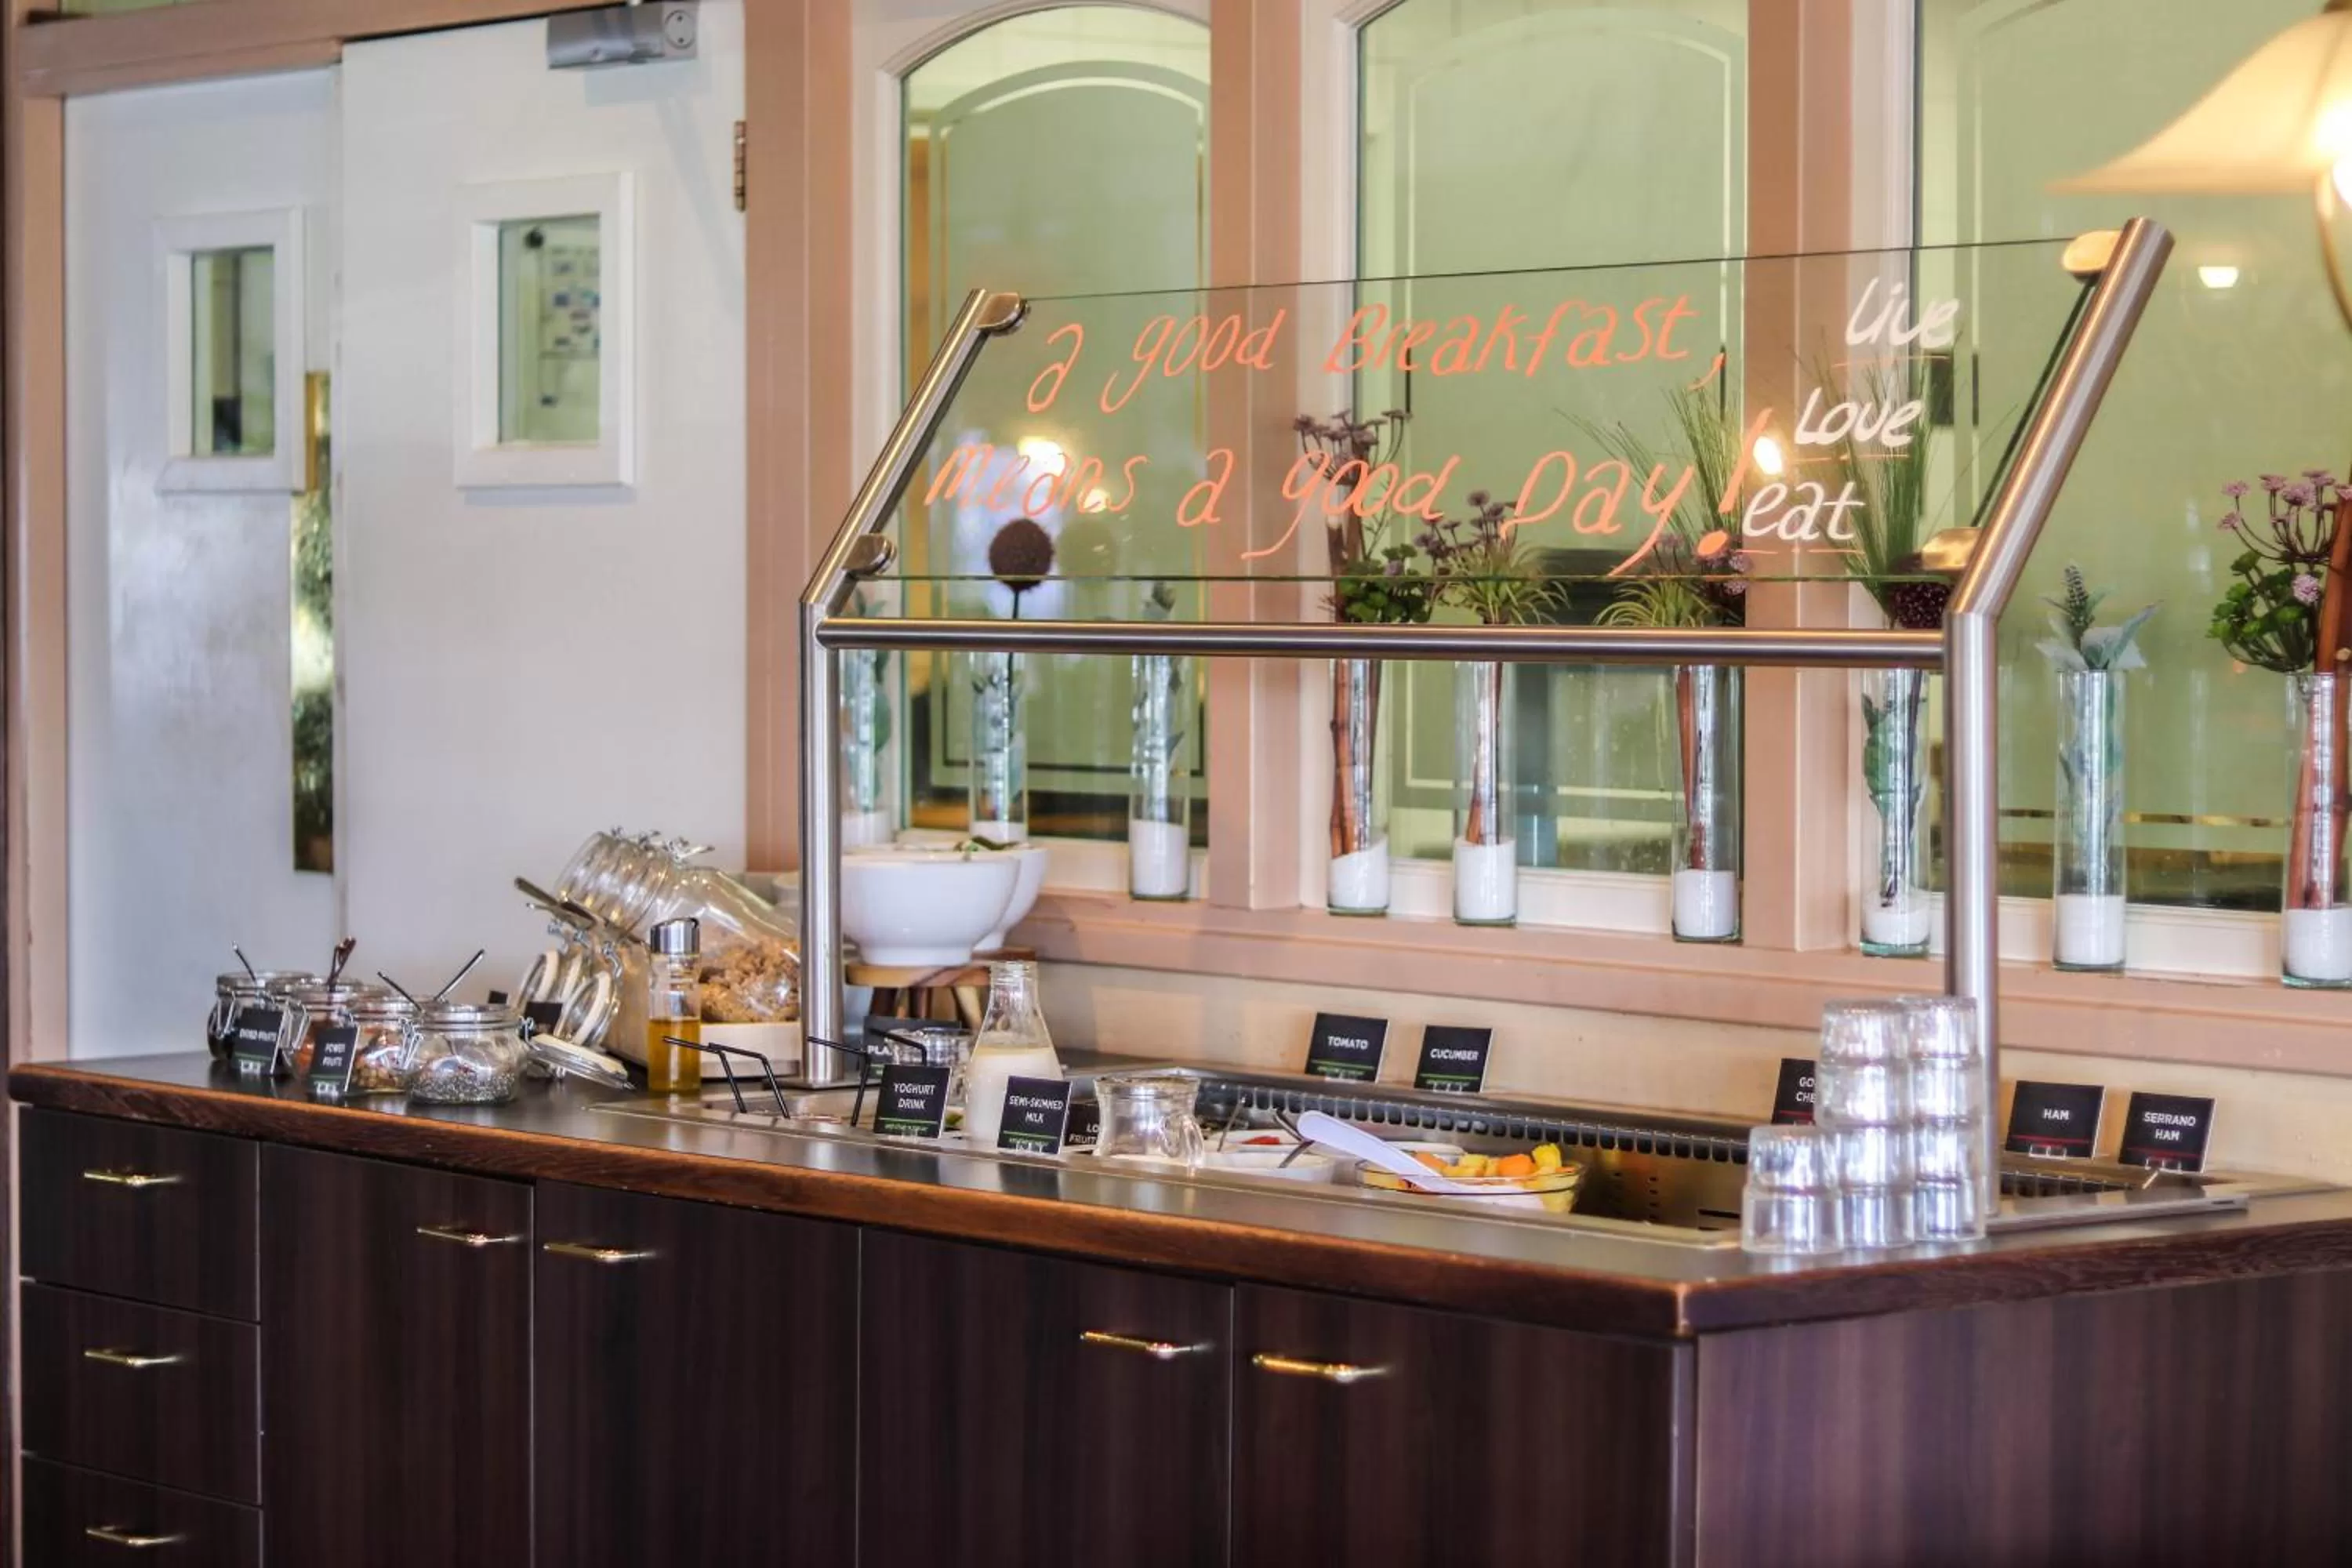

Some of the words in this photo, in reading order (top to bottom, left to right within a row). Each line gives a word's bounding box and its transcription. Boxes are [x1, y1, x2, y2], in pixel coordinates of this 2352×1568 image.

[1026, 322, 1084, 413] a
[1100, 307, 1287, 414] good
[1793, 386, 1924, 449] Love
[924, 441, 1152, 517] means
[1176, 447, 1234, 528] a
[1240, 448, 1464, 561] good
[1740, 479, 1867, 542] eat
[1327, 1035, 1369, 1051] TOMATO
[1429, 1047, 1479, 1062] CUCUMBER
[893, 1082, 936, 1096] YOGHURT
[897, 1097, 927, 1110] DRINK
[1008, 1094, 1064, 1112] SEMI-SKIMMED
[1025, 1111, 1046, 1124] MILK
[2042, 1107, 2071, 1122] HAM
[2143, 1110, 2197, 1127] SERRANO
[2154, 1127, 2181, 1142] HAM
